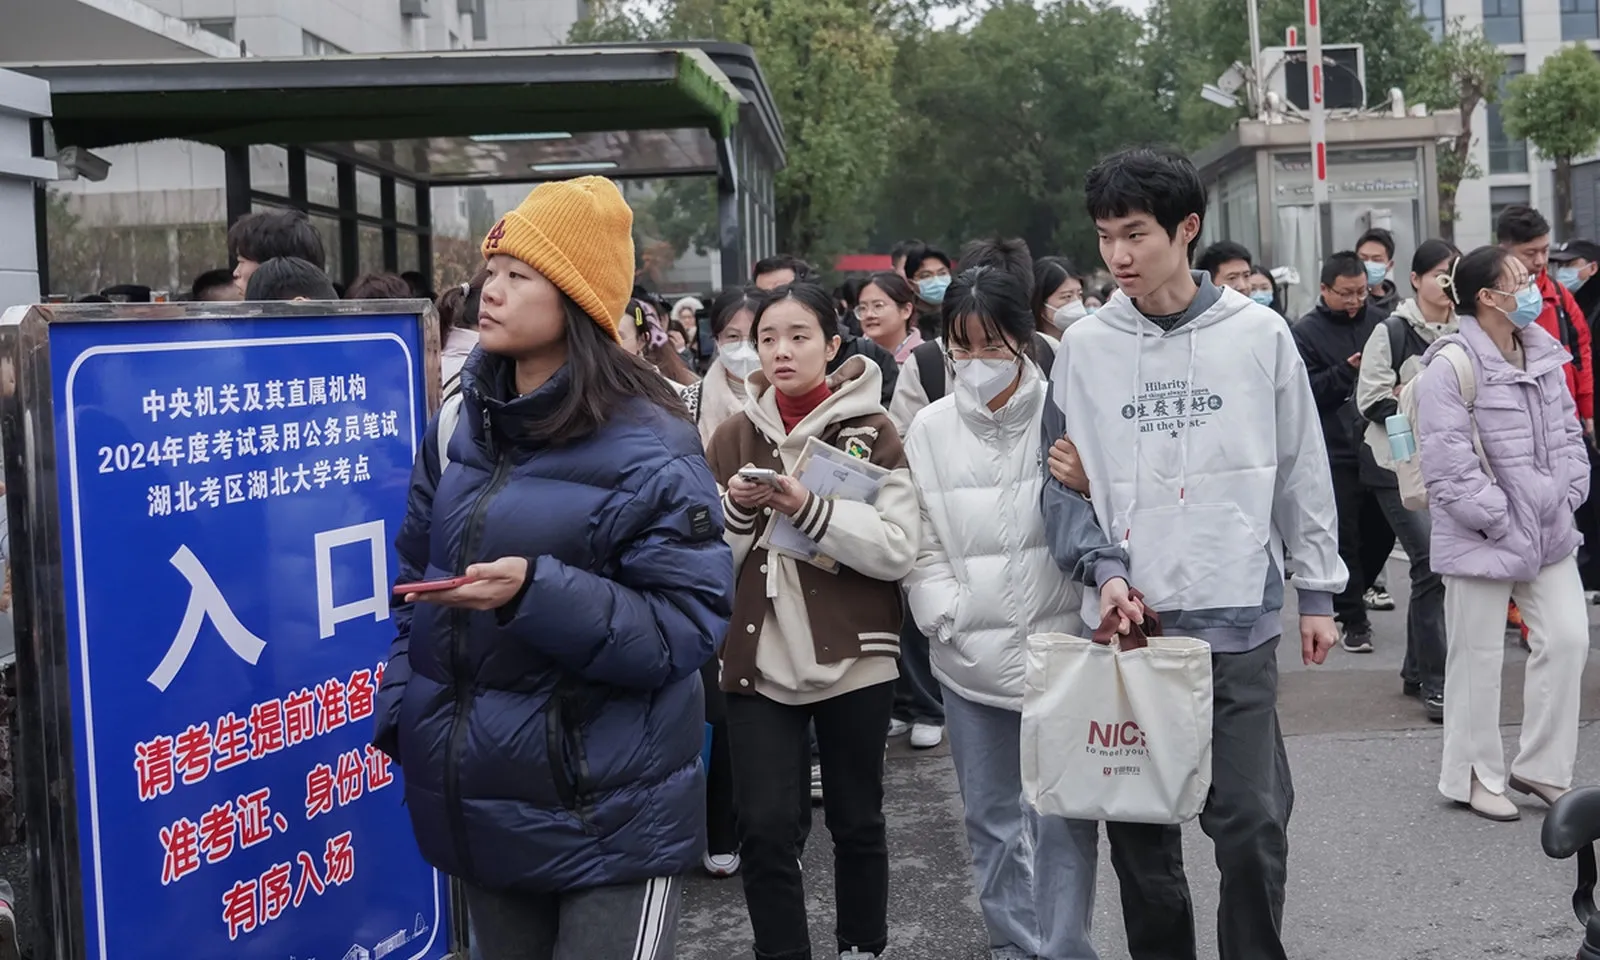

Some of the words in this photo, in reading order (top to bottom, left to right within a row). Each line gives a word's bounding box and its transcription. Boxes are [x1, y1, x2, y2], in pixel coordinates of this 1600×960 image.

[142, 373, 367, 423] 中央机关及其直属机构
[1140, 422, 1154, 433] all
[1157, 421, 1174, 431] the
[98, 410, 400, 474] 2024年度考试录用公务员笔试
[148, 454, 371, 517] 湖北考区湖北大学考点
[147, 519, 390, 692] 入口
[134, 661, 390, 801] 请考生提前准备
[1086, 746, 1096, 754] to
[1100, 748, 1122, 757] meet
[160, 744, 393, 885] 准考证、身份证
[222, 831, 356, 940] 有序入场
